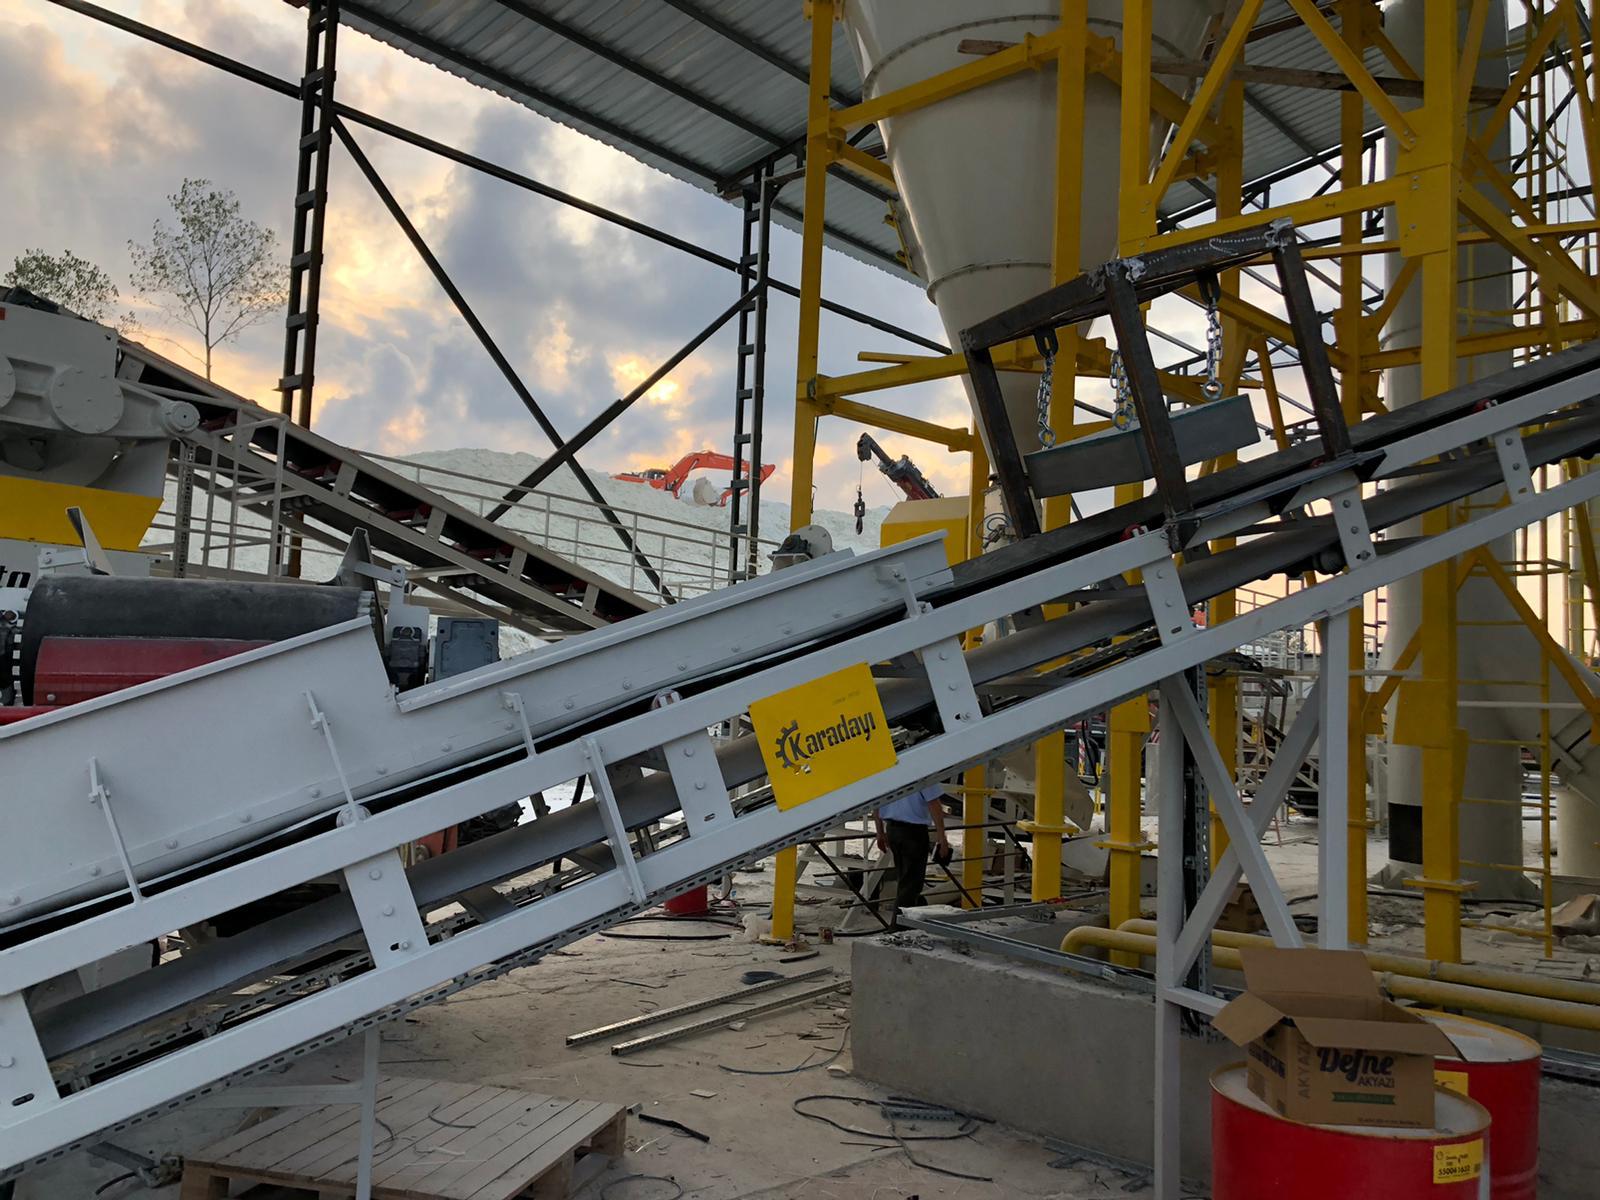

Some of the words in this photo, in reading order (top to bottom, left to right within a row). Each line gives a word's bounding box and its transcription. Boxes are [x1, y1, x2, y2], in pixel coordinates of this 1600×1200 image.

[788, 711, 876, 761] Karadayı
[1317, 1047, 1394, 1082] Defne
[1357, 1075, 1395, 1089] AKYAZI
